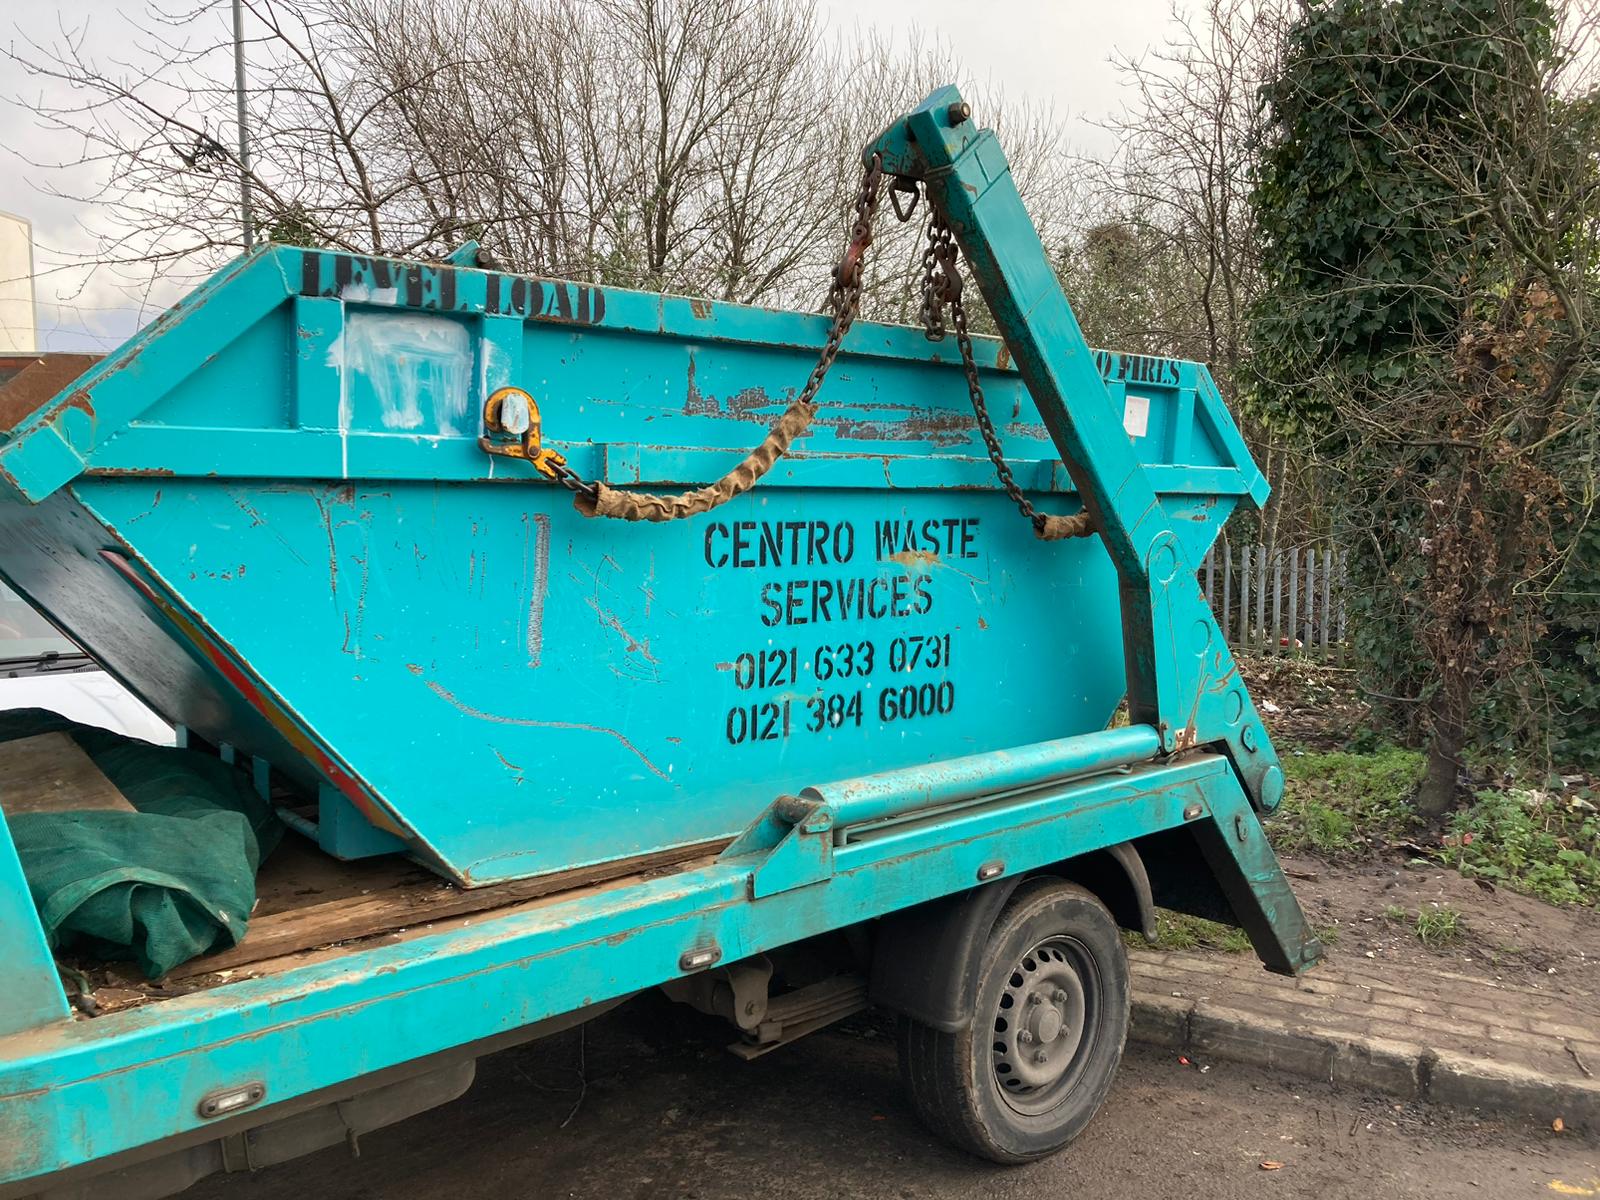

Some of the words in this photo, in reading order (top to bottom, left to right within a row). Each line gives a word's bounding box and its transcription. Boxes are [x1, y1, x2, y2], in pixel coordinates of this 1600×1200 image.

[486, 274, 606, 325] LOAD
[1117, 354, 1180, 385] FIRES
[704, 521, 854, 568] CENTRO
[874, 518, 980, 561] WASTE
[760, 575, 933, 627] SERVICES
[734, 648, 797, 690] 0121
[814, 641, 874, 680] 633
[889, 633, 950, 673] 0731
[726, 700, 790, 744] 0121
[806, 691, 863, 732] 384
[879, 682, 954, 722] 6000
